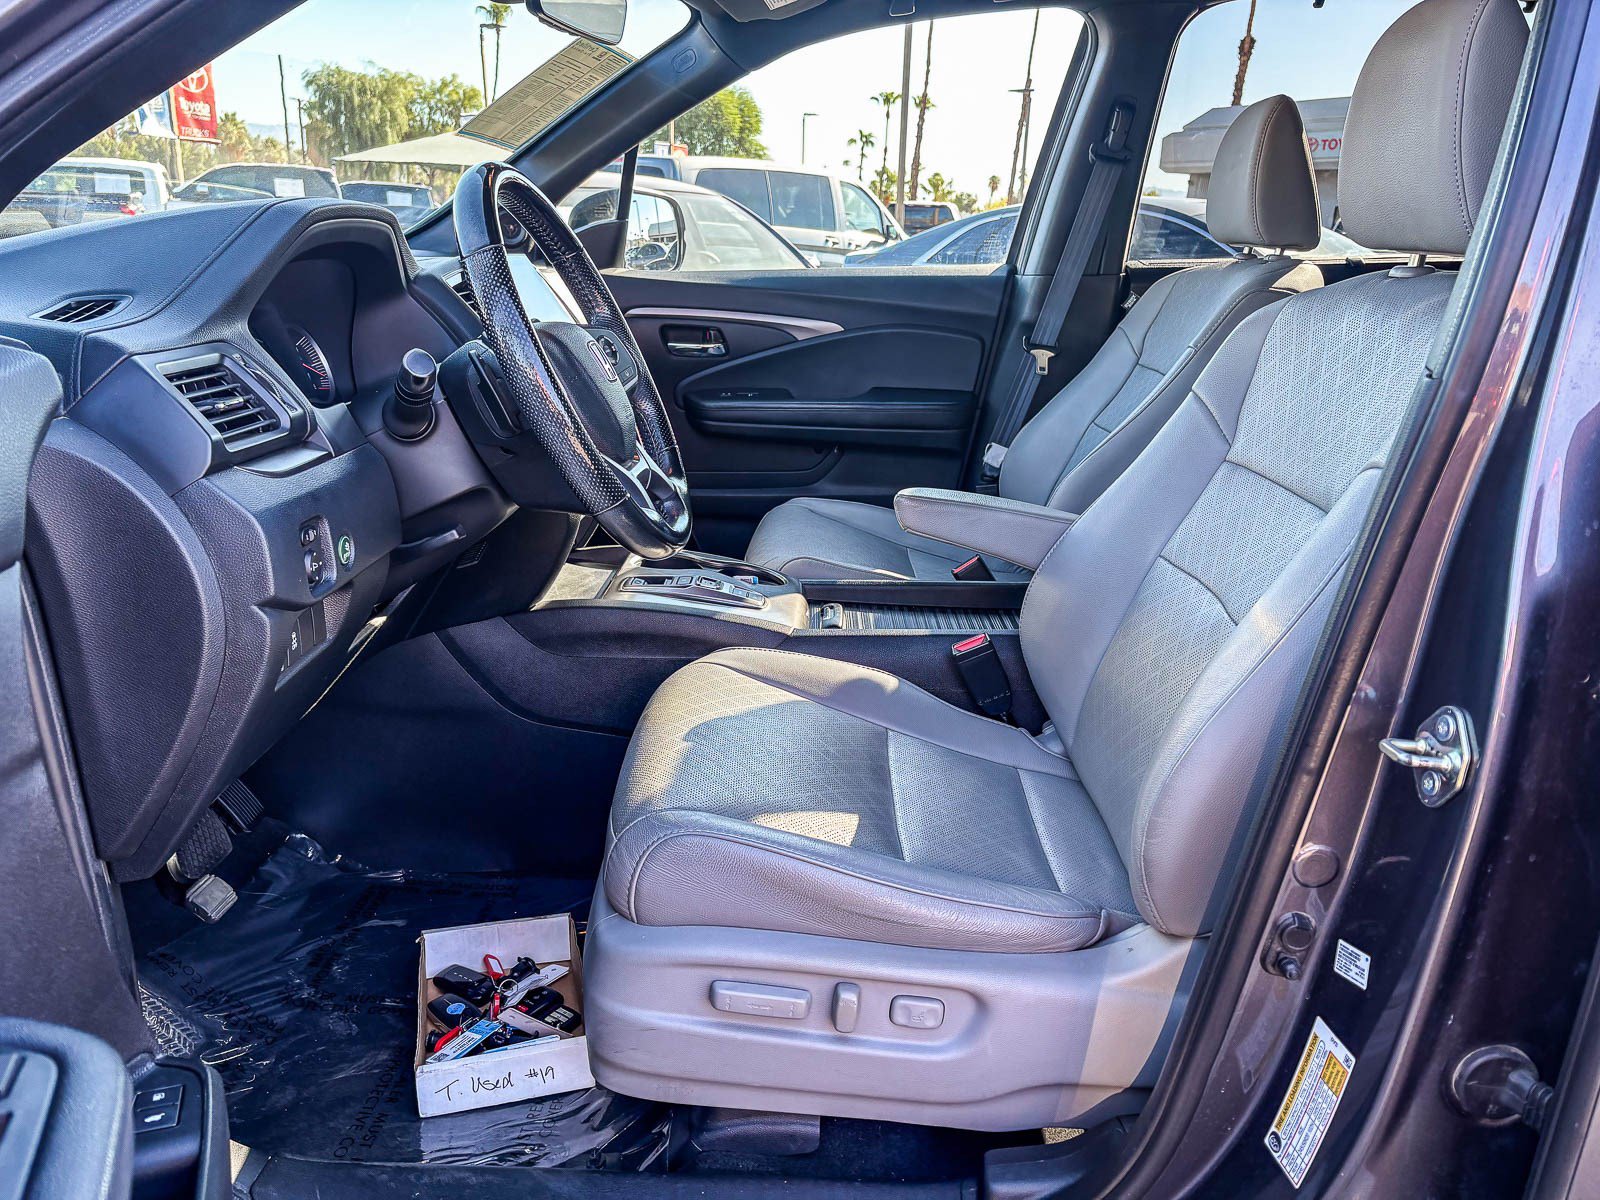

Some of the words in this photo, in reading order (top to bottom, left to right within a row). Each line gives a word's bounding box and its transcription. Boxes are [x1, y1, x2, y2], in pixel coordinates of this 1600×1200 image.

[178, 96, 211, 115] Toyota
[434, 1078, 463, 1102] T.
[471, 1071, 514, 1093] Used
[524, 1065, 555, 1084] #19
[1281, 1101, 1290, 1116] AND
[360, 1112, 389, 1149] MUST
